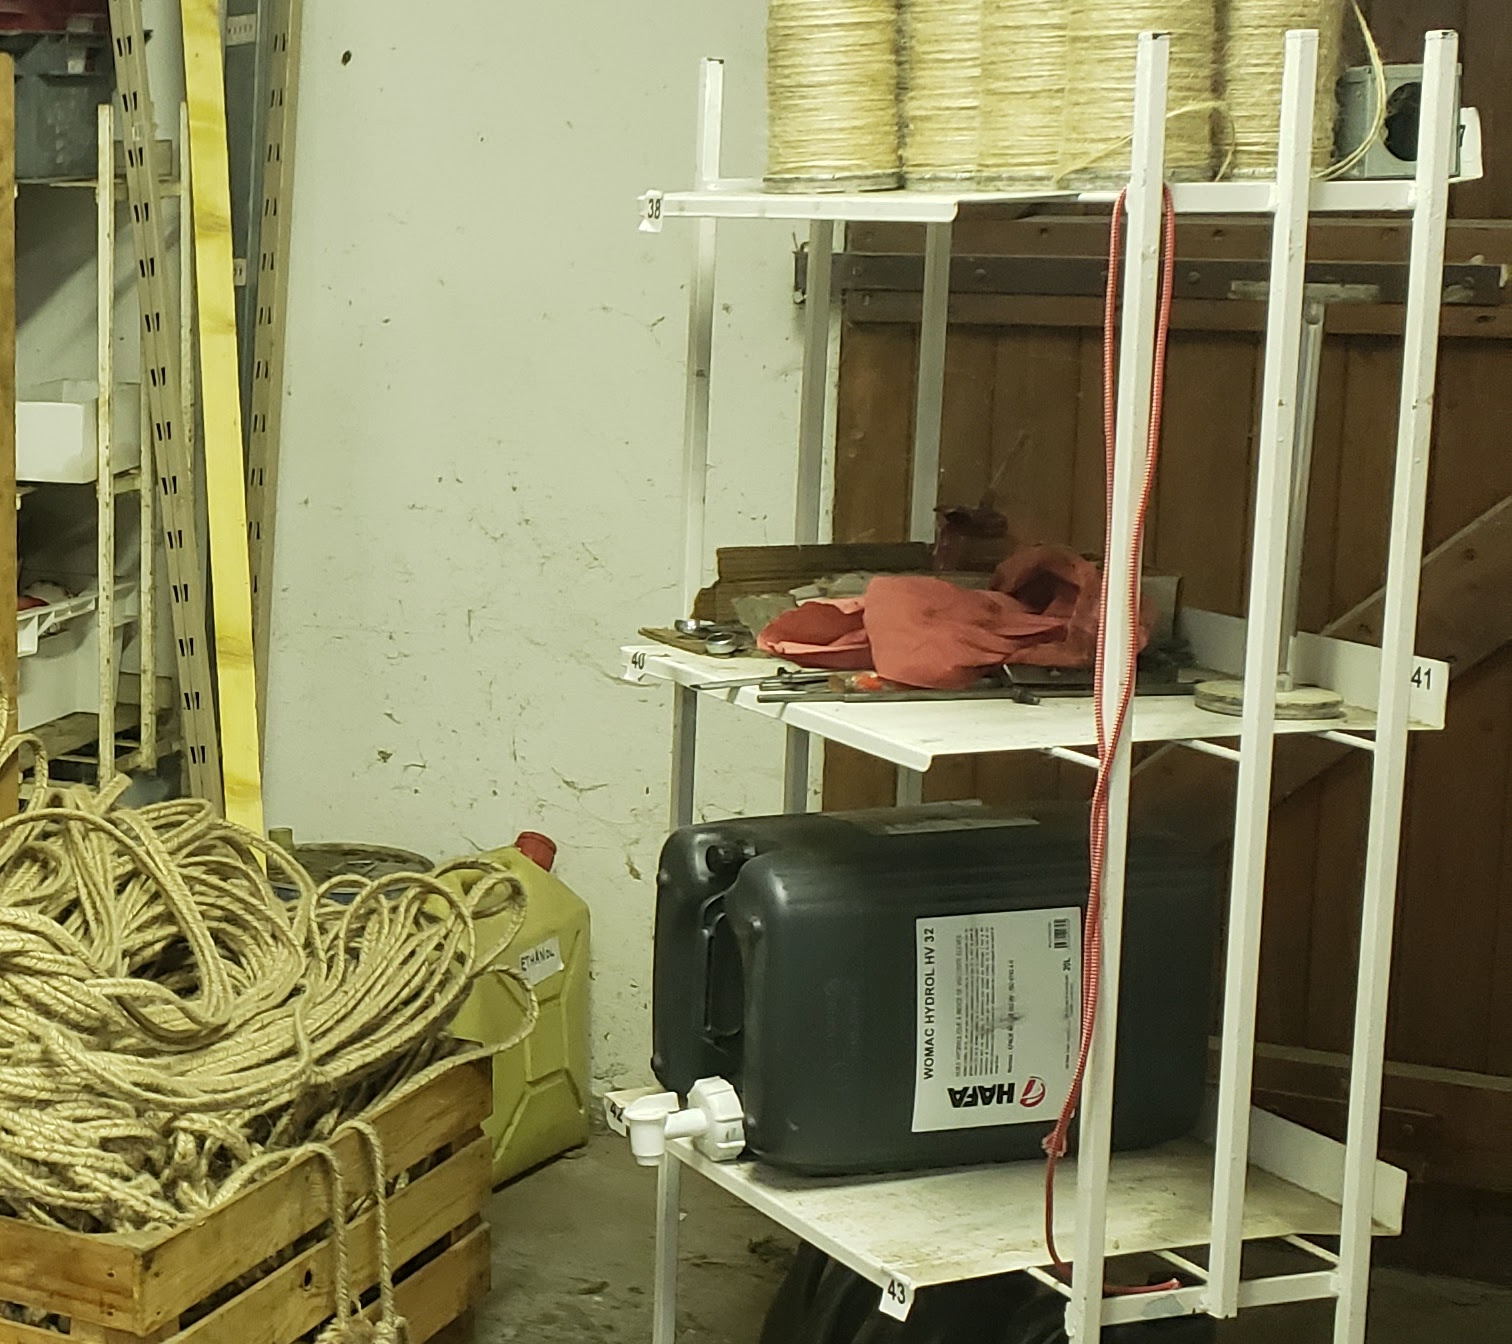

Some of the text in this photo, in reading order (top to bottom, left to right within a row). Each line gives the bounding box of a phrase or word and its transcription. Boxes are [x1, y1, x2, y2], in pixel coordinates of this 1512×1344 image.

[648, 199, 660, 219] 38
[631, 651, 646, 670] 40
[1410, 666, 1431, 690] 41
[521, 947, 555, 972] ETHANOL
[924, 927, 935, 1080] WOMAC HYDROL HV 32
[947, 1083, 1015, 1108] HAFA
[888, 1279, 905, 1304] 43
